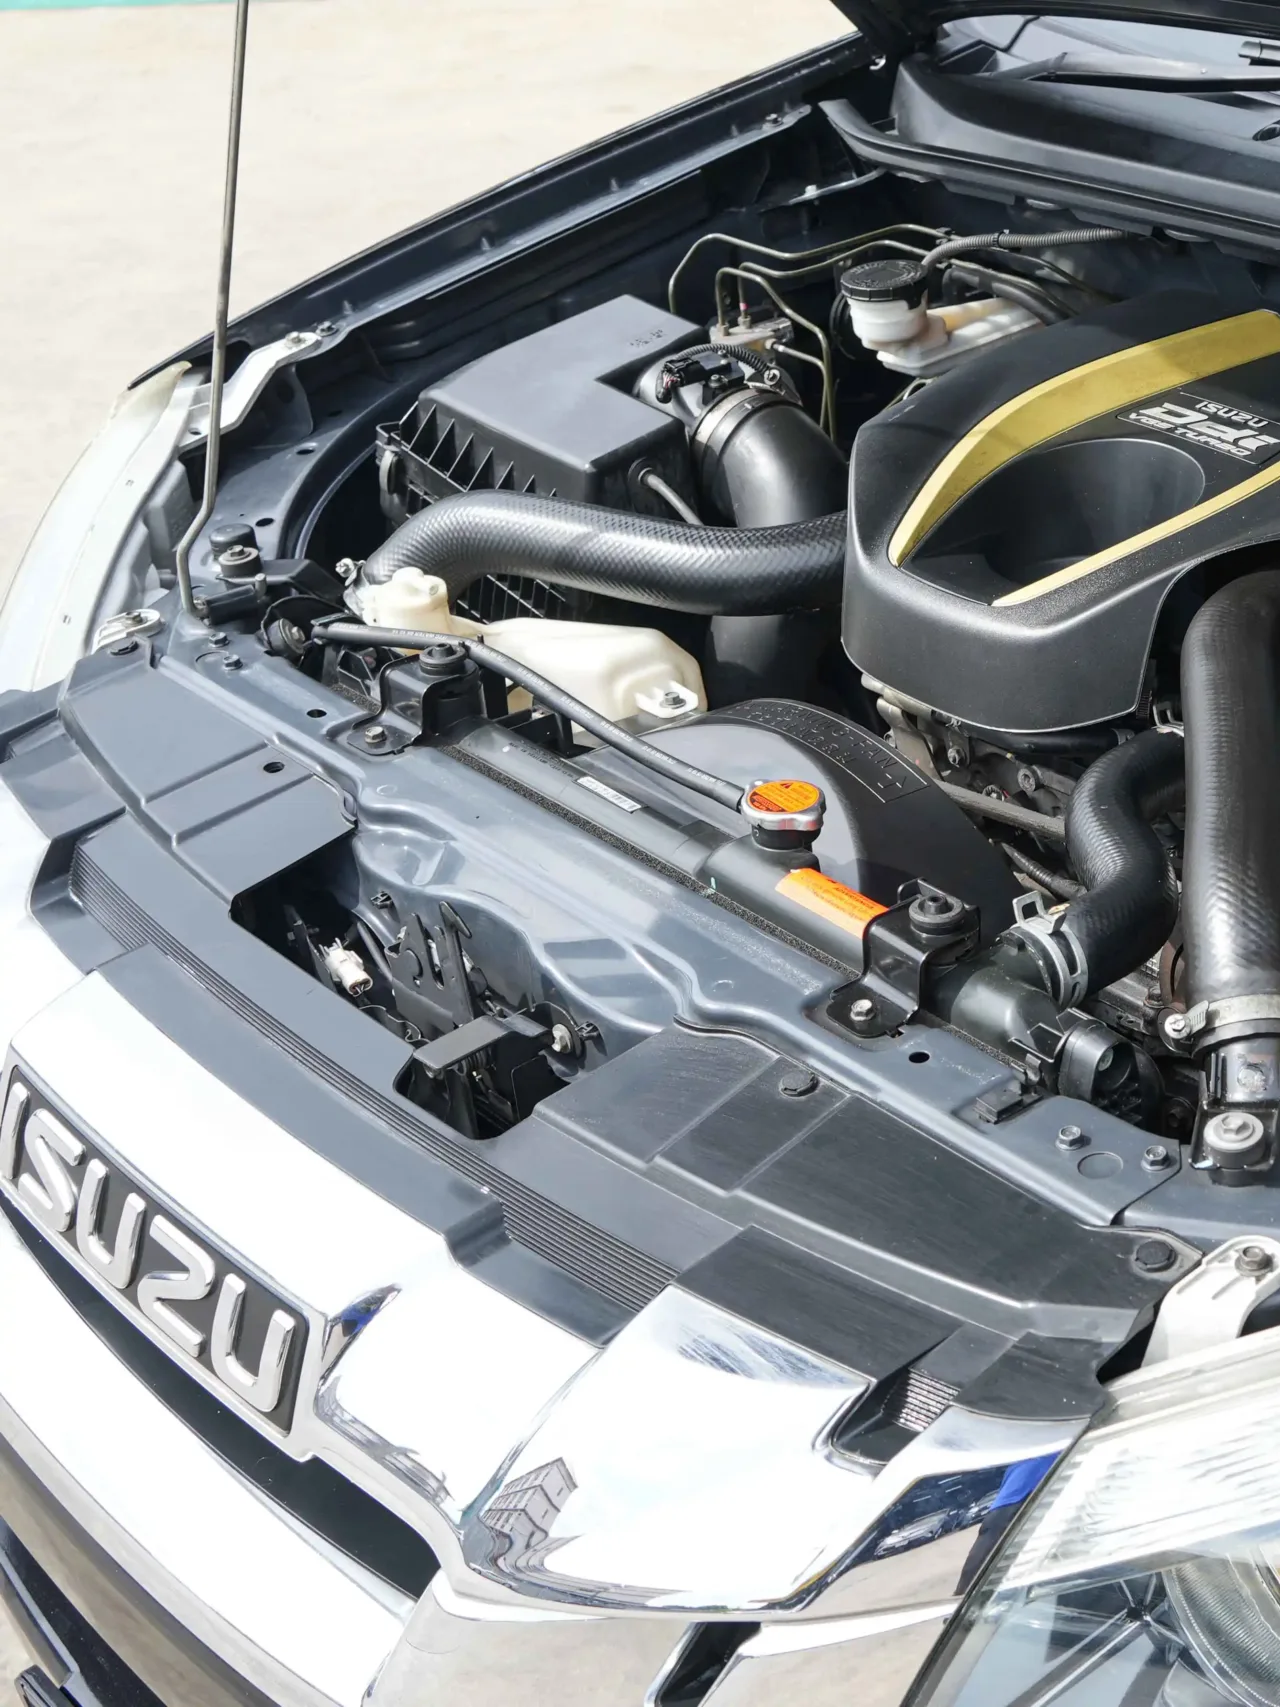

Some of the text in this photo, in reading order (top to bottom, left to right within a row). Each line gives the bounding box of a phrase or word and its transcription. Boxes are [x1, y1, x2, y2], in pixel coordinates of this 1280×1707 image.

[1129, 412, 1252, 456] VGS TURBO
[1195, 401, 1268, 428] ISUZU
[0, 1081, 296, 1412] ISUZU
